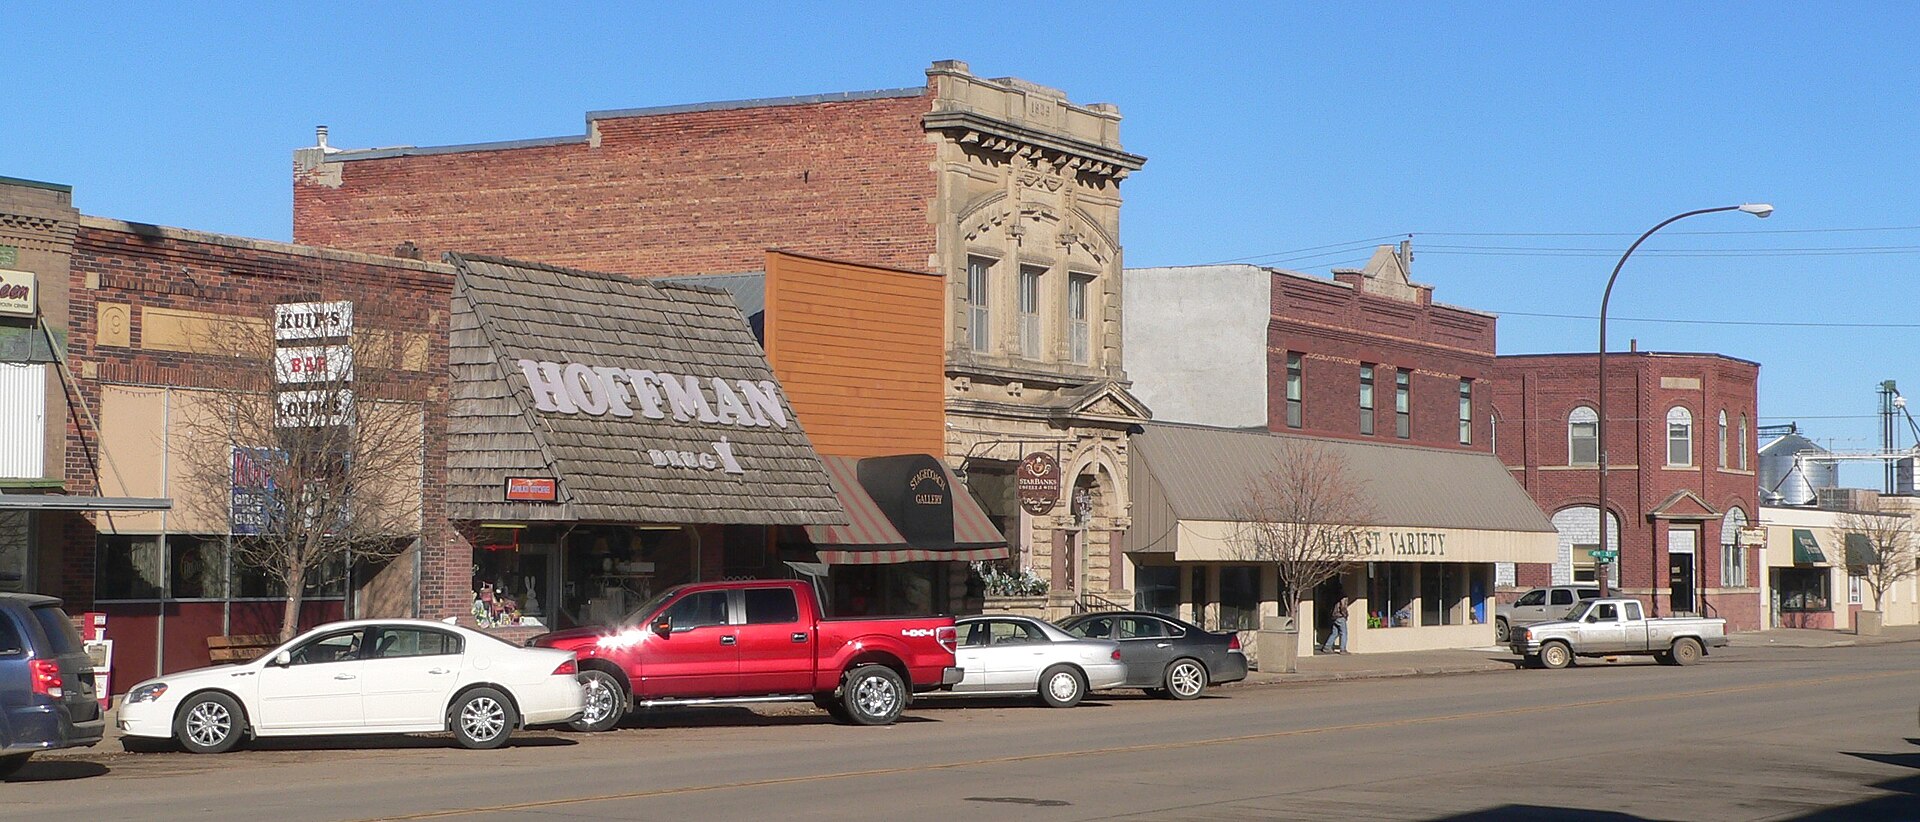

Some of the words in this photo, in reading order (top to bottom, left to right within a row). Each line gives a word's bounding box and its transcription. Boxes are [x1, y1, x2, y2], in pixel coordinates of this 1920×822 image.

[290, 356, 326, 373] BAR
[517, 359, 787, 429] HOFFMAN
[647, 449, 717, 471] DRUG
[910, 468, 946, 491] STAGECOACH
[915, 494, 943, 505] GALLERY
[1320, 529, 1361, 555] MAIN
[1366, 531, 1385, 556] ST.
[1390, 531, 1447, 556] VARIETY
